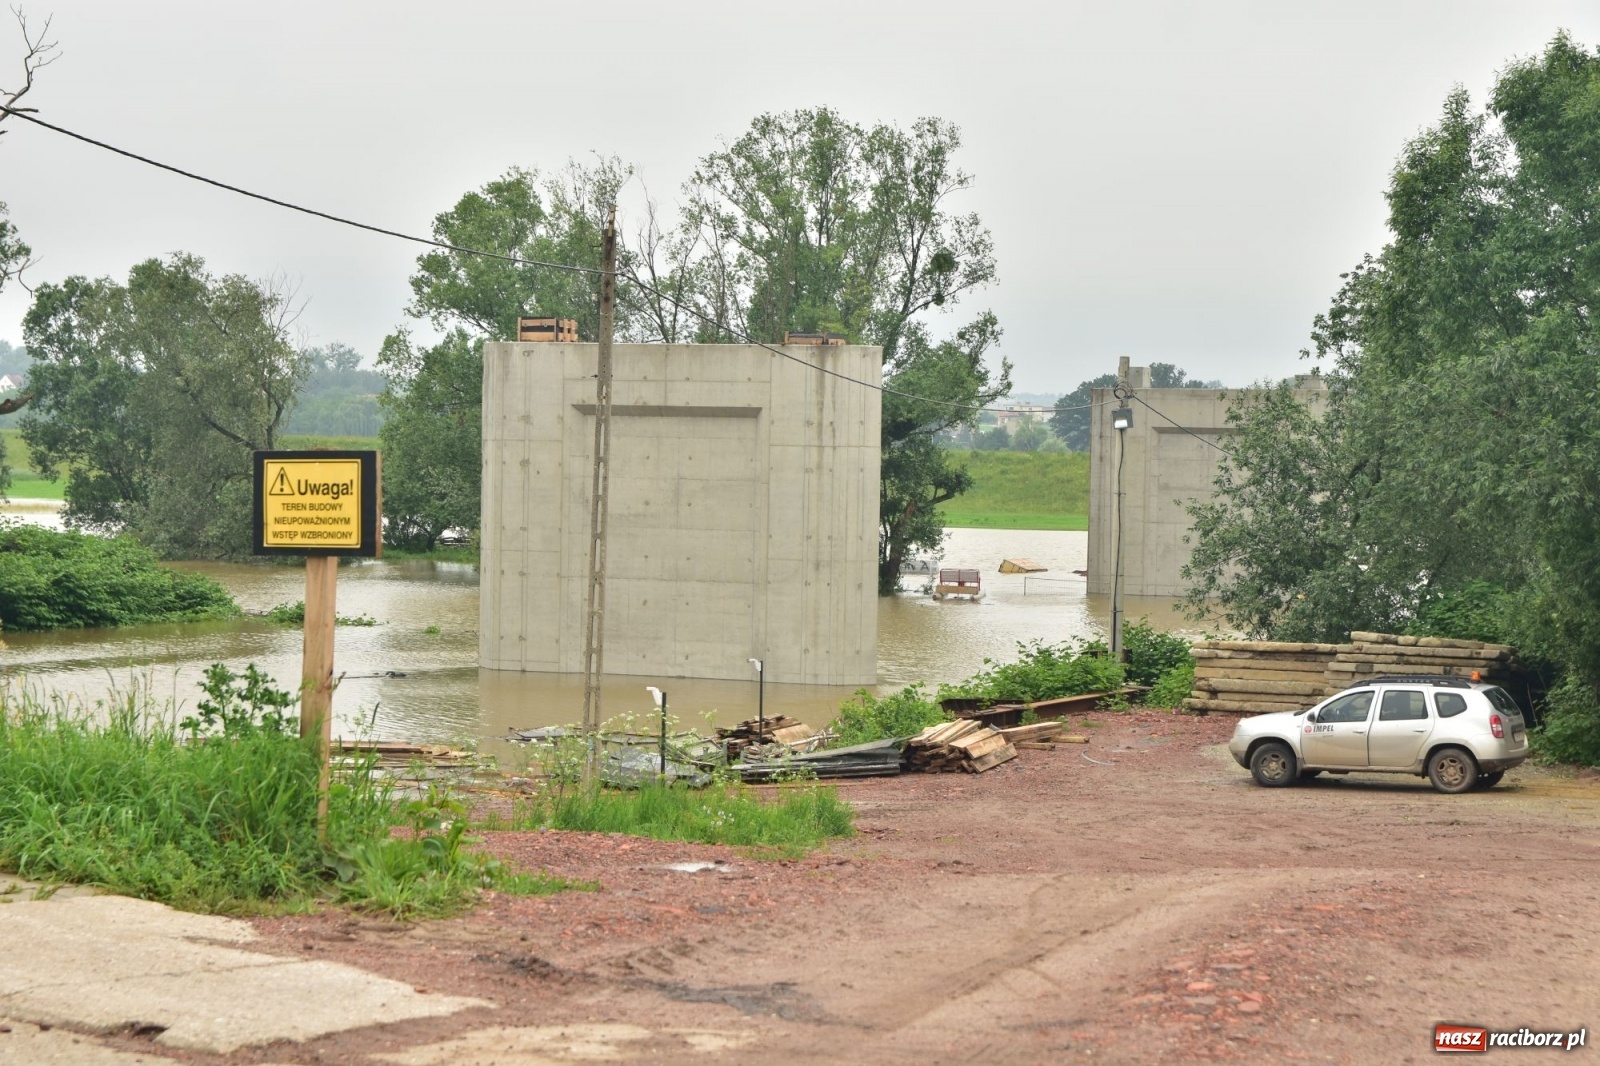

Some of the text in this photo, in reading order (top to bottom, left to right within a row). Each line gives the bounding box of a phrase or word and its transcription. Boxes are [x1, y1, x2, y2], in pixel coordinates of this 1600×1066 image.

[297, 479, 353, 500] Uwaga!
[281, 502, 343, 511] TEREN BUDOWY
[274, 515, 350, 525] NIEUPOWAŻNIONYM
[272, 530, 353, 540] WSTĘP WZBRONIONY
